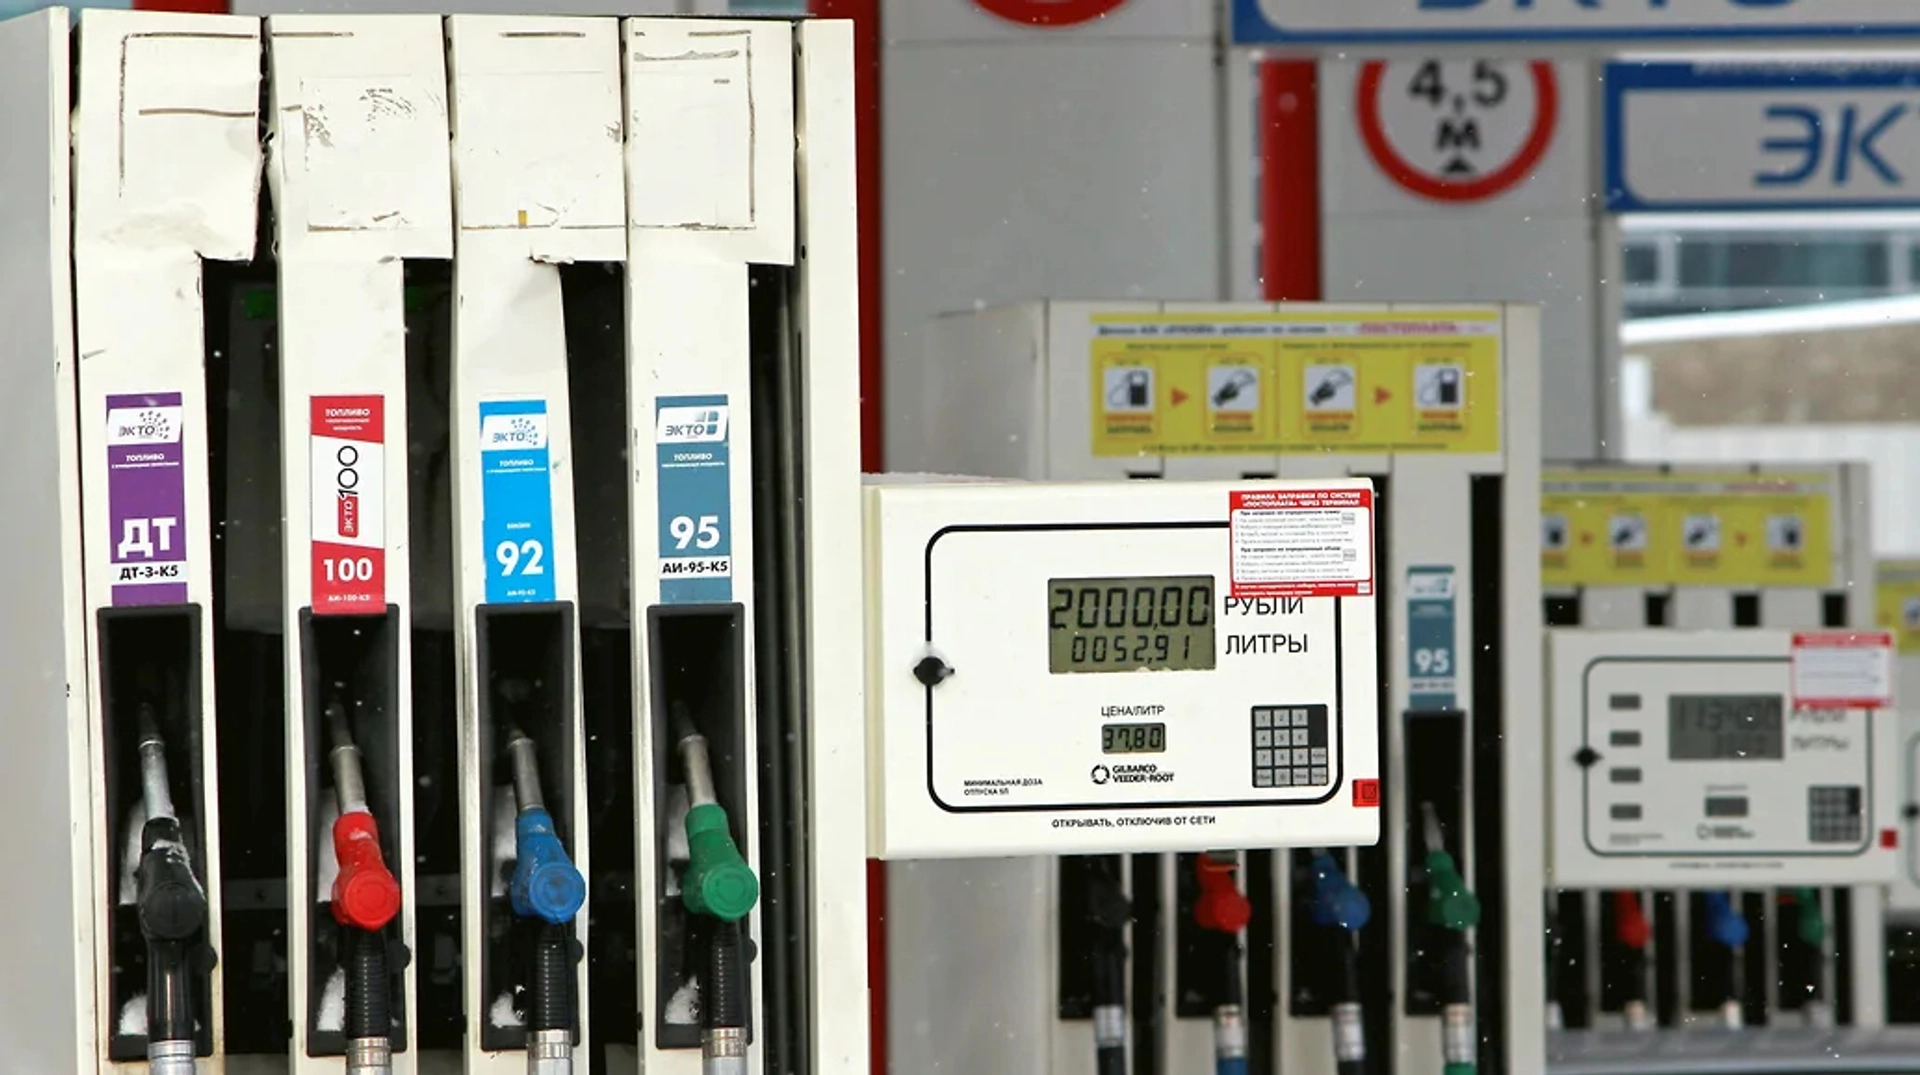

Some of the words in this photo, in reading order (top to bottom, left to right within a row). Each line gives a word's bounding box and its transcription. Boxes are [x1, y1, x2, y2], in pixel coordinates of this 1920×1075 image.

[1407, 60, 1507, 115] 4,5
[1436, 117, 1481, 151] М
[1754, 102, 1920, 186] ЭК
[119, 424, 156, 437] ЭКТО
[492, 432, 525, 443] ЭКТО
[665, 423, 705, 437] ЭКТО
[338, 445, 360, 498] 100
[118, 517, 177, 559] ДТ
[670, 516, 720, 549] 95
[323, 558, 373, 582] 100
[496, 540, 543, 576] 92
[662, 561, 728, 574] АИ-95-К5
[1050, 586, 1210, 630] 2000,00
[1225, 596, 1303, 616] РУБЛИ
[1071, 635, 1190, 664] 0052,91
[1225, 634, 1309, 655] ЛИТРЫ
[1415, 648, 1450, 673] 95
[1101, 705, 1165, 717] ЦЕНА/ЛИТР
[1103, 727, 1162, 751] 37,80
[1116, 817, 1172, 827] ОТКЛЮЧИВ
[1174, 816, 1187, 826] ОТ
[1189, 815, 1216, 825] СЕТИ
